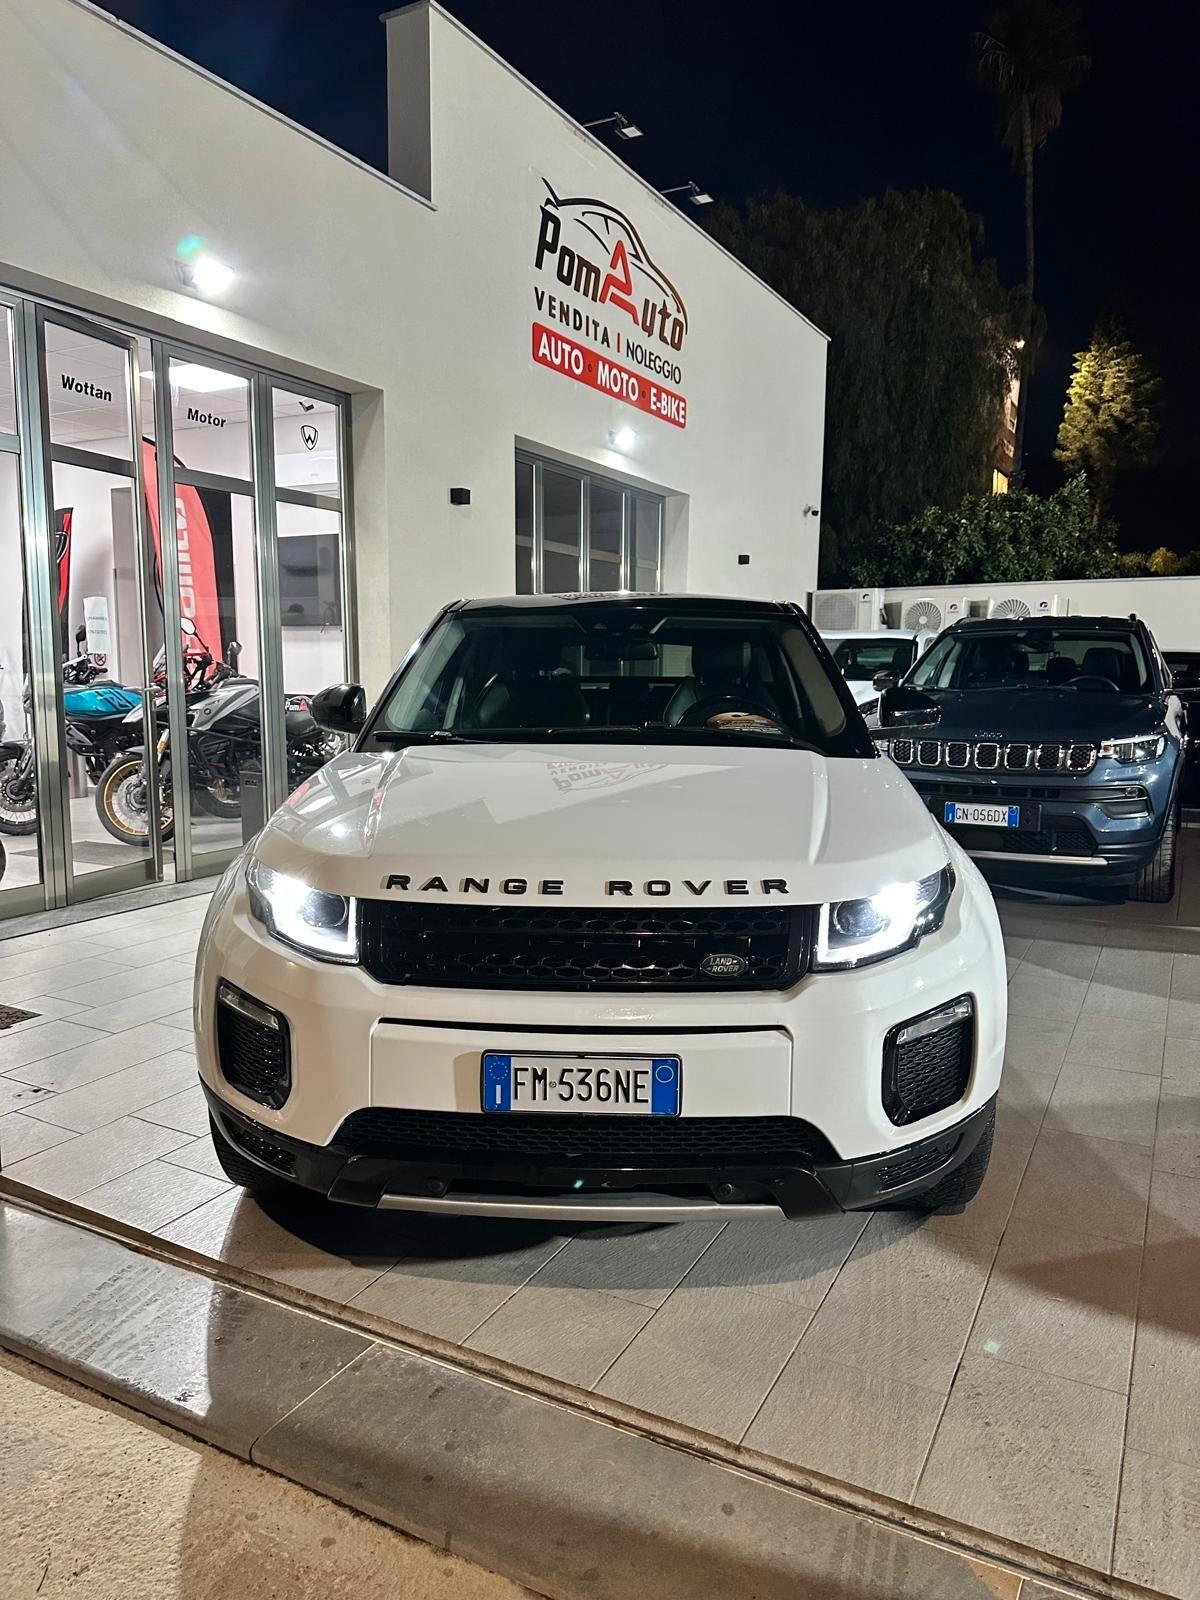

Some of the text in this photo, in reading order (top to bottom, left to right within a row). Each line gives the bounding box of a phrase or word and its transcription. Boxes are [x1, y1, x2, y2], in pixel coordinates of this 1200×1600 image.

[534, 286, 682, 385] VENDITA NOLEGGIO
[61, 374, 112, 402] Wottan
[538, 332, 686, 424] AUTO MOTO E-BIKE
[187, 407, 227, 428] Motor
[385, 873, 791, 897] RANGE ROVER
